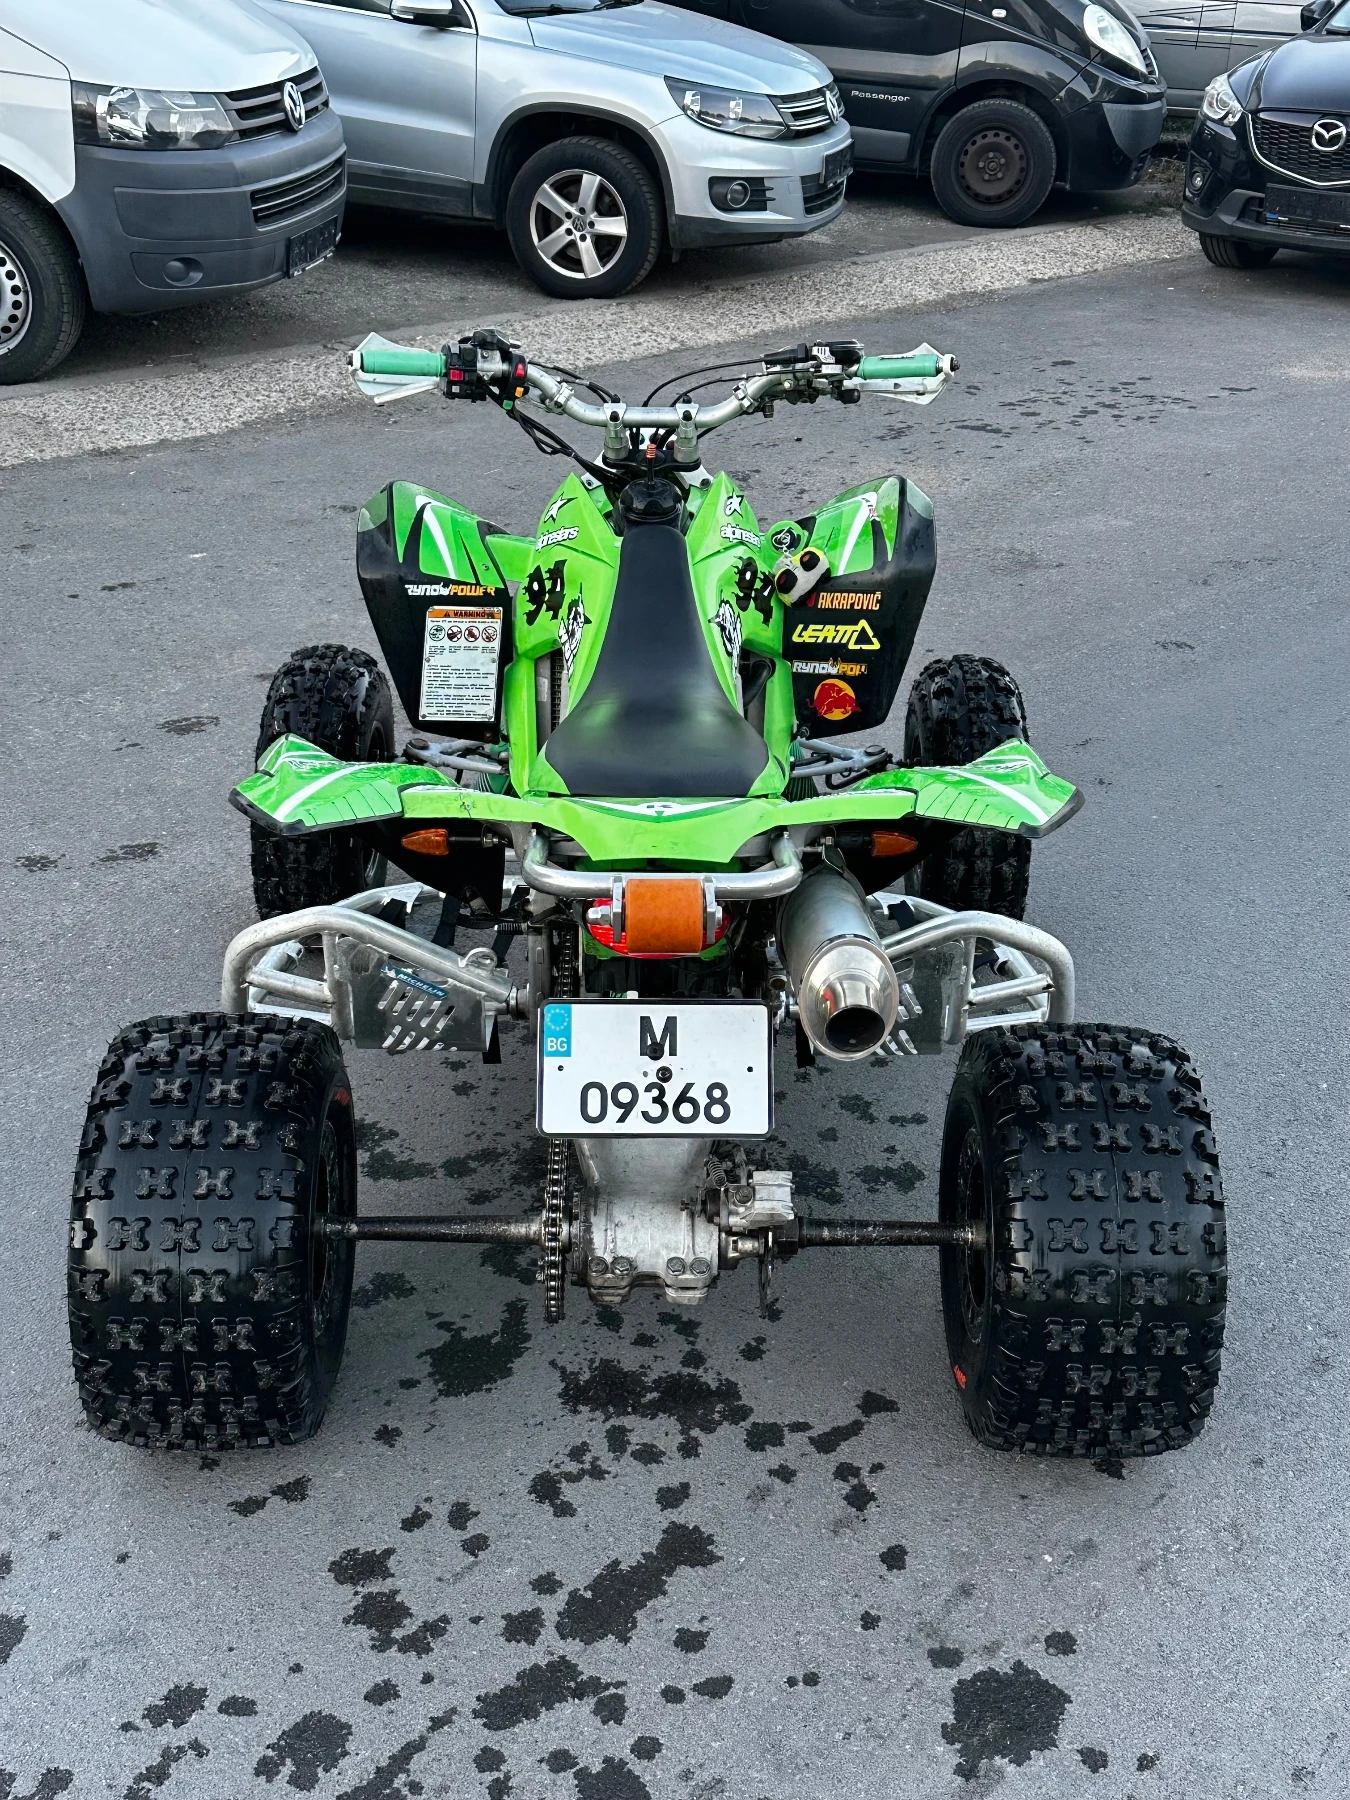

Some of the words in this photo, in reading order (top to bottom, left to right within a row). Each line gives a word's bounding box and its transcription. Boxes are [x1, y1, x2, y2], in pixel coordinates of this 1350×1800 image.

[851, 90, 910, 103] Passenger
[453, 610, 486, 618] WARNING
[397, 973, 446, 996] MICHELIN
[547, 1037, 568, 1051] BG
[639, 1015, 678, 1057] M
[580, 1081, 731, 1124] 09368
